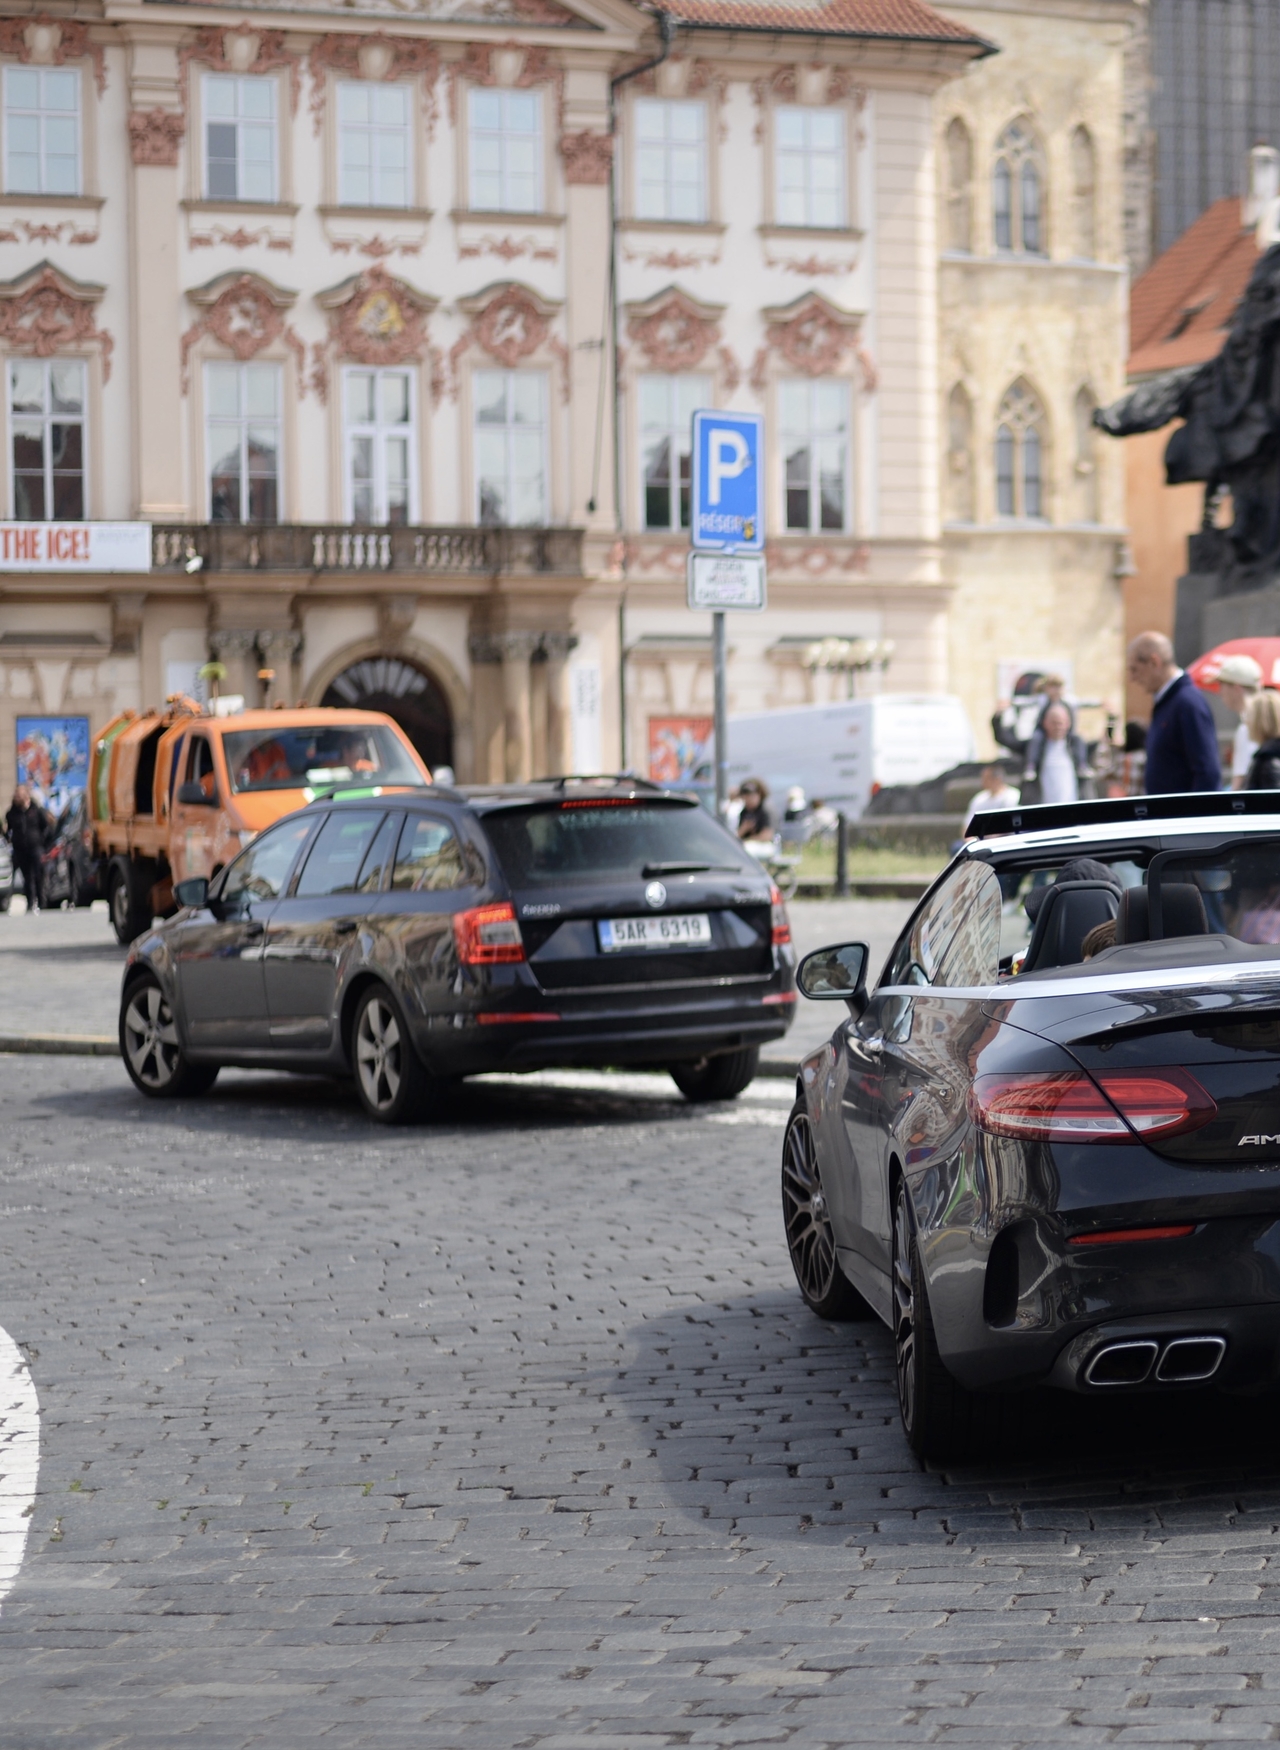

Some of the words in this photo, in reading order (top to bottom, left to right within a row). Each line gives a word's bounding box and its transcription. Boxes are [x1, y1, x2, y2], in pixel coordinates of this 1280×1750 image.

[708, 428, 750, 506] P
[699, 510, 757, 535] RÉSER
[0, 527, 40, 560] THE
[47, 527, 90, 560] ICE!
[615, 921, 646, 940] 5AR
[660, 919, 701, 938] 6319
